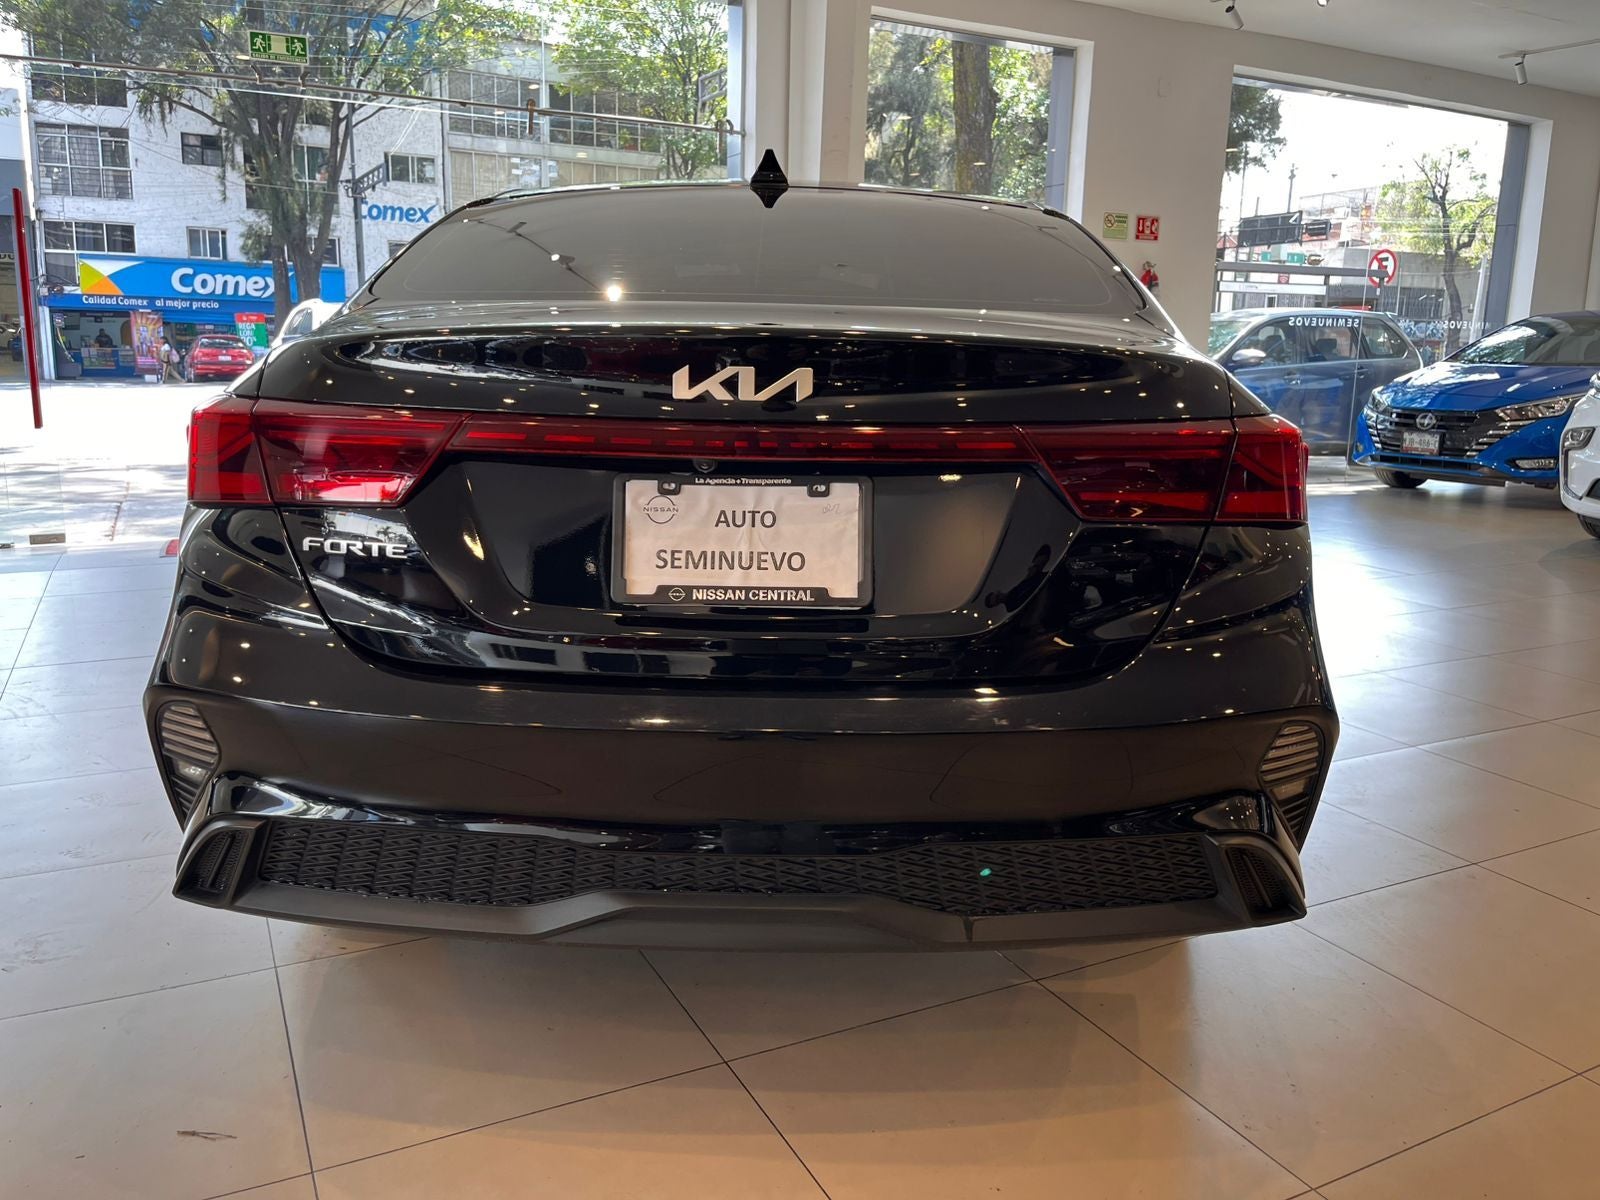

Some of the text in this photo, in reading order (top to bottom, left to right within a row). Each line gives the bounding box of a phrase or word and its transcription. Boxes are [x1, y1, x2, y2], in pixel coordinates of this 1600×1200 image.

[362, 200, 438, 223] omex
[82, 295, 219, 310] Calidad Comex al mejor precio
[672, 364, 814, 403] KIA
[705, 477, 735, 485] Agencia
[714, 509, 777, 529] AUTO
[302, 537, 408, 559] FORTE
[655, 548, 806, 572] SEMINUEVO
[692, 588, 815, 602] NISSAN CENTRAL
